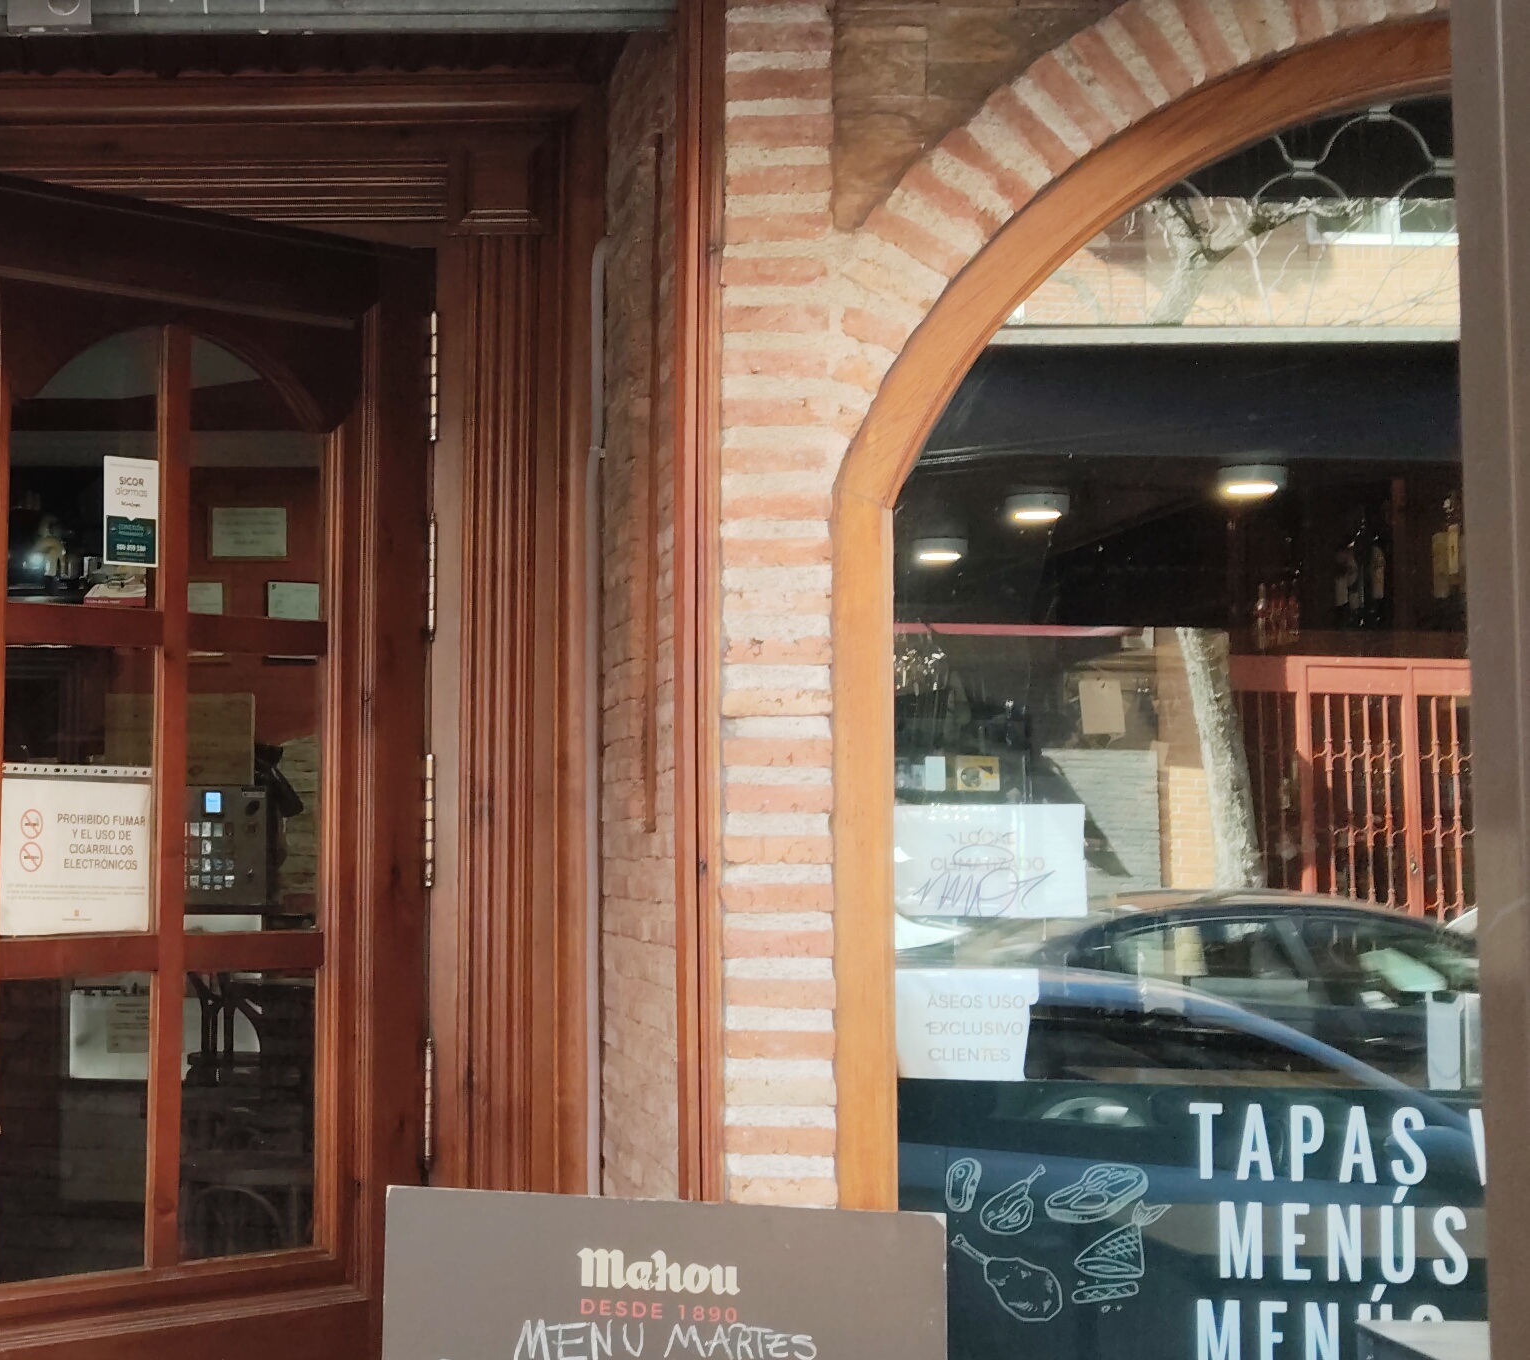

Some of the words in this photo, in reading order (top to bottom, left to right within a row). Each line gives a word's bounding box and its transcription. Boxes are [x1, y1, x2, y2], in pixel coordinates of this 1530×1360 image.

[57, 813, 110, 826] PROHIBIDO
[112, 815, 146, 827] FUMAR
[72, 829, 79, 840] Y
[80, 829, 93, 840] EL
[95, 830, 116, 841] USO
[118, 830, 132, 841] DE
[69, 843, 134, 856] CIGARRILLOS
[63, 857, 138, 871] ELECTRÓNICOS
[927, 994, 983, 1009] ASEOS
[988, 995, 1026, 1009] USO
[927, 1021, 1024, 1036] EXCLUSIVO
[928, 1047, 1011, 1063] CLIENTES
[1188, 1102, 1427, 1186] TAPAS
[1218, 1185, 1469, 1285] MENÚS
[578, 1248, 741, 1296] Mahou
[580, 1298, 664, 1320] DESDE
[677, 1304, 738, 1323] 1890
[663, 1322, 818, 1360] MARTES
